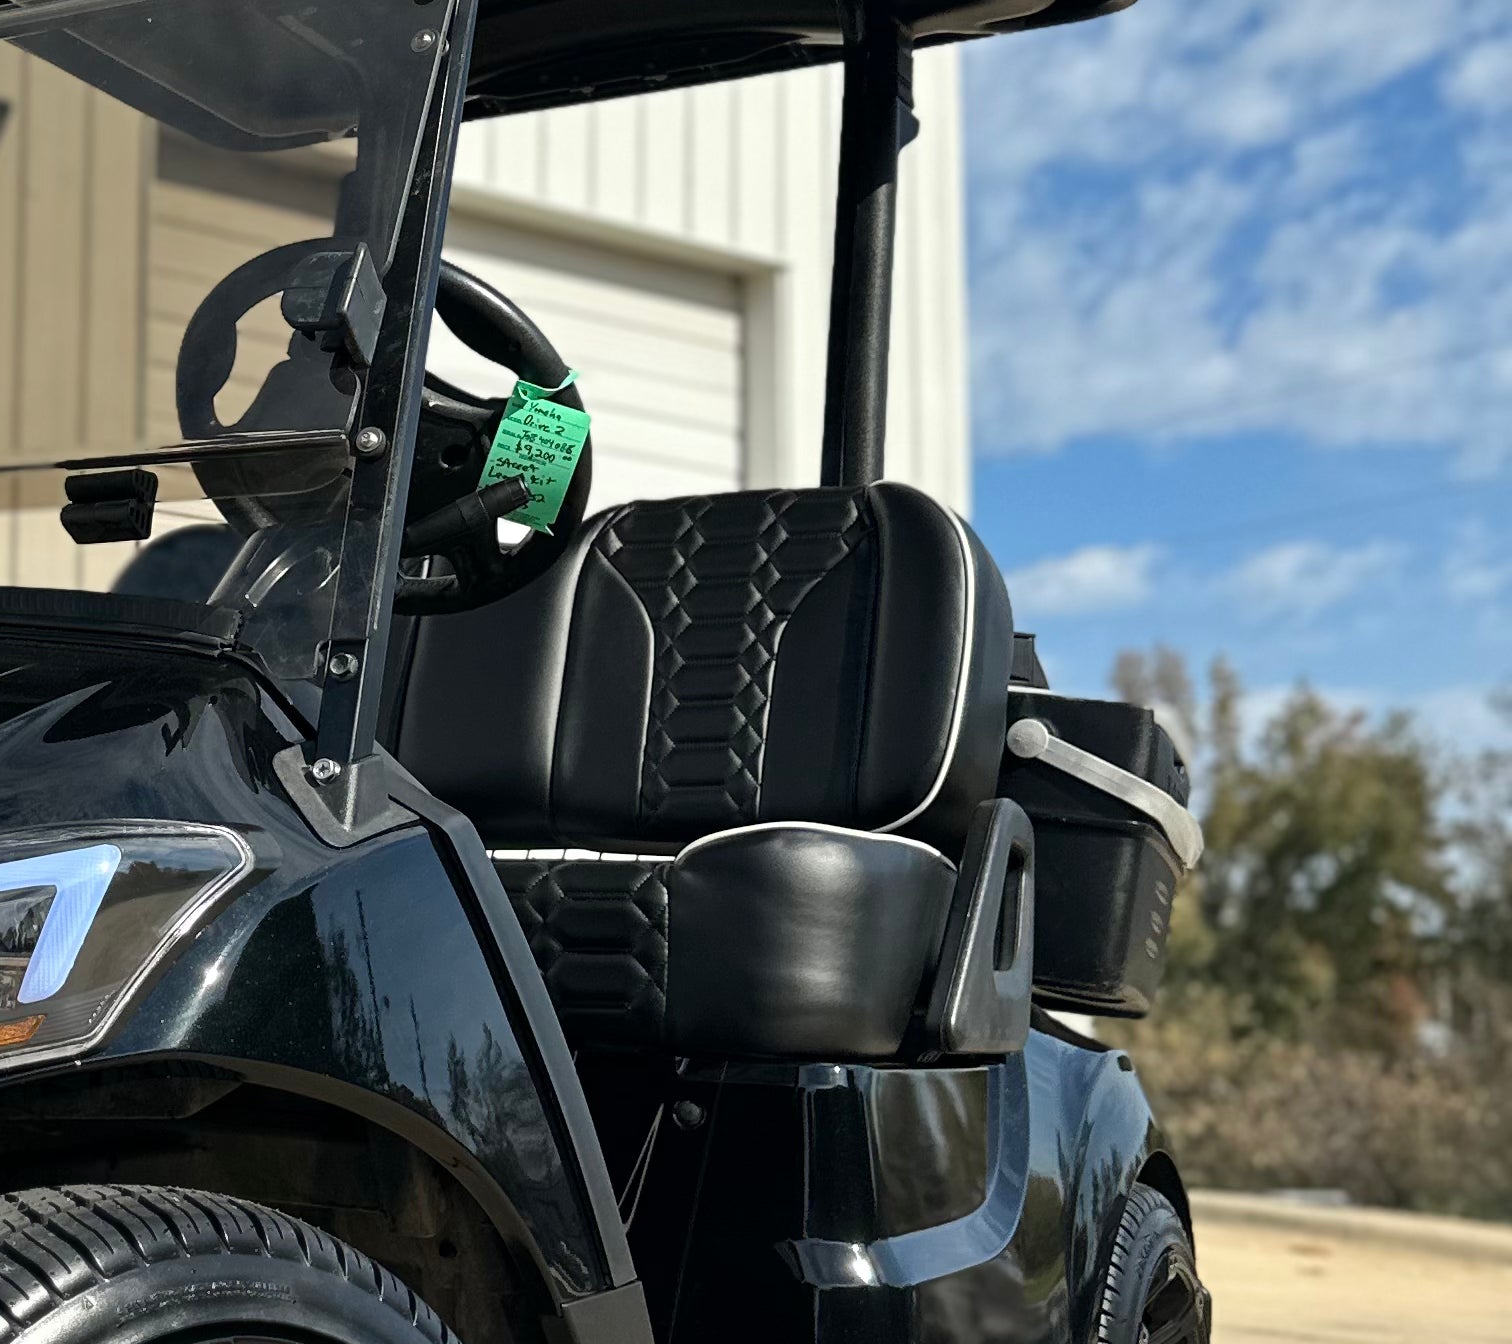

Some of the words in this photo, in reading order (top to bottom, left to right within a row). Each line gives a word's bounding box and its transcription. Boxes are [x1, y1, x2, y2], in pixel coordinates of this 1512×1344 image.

[529, 402, 562, 421] Yamaha
[523, 414, 550, 433] Drive
[554, 425, 566, 437] 2
[515, 439, 556, 463] $9,200
